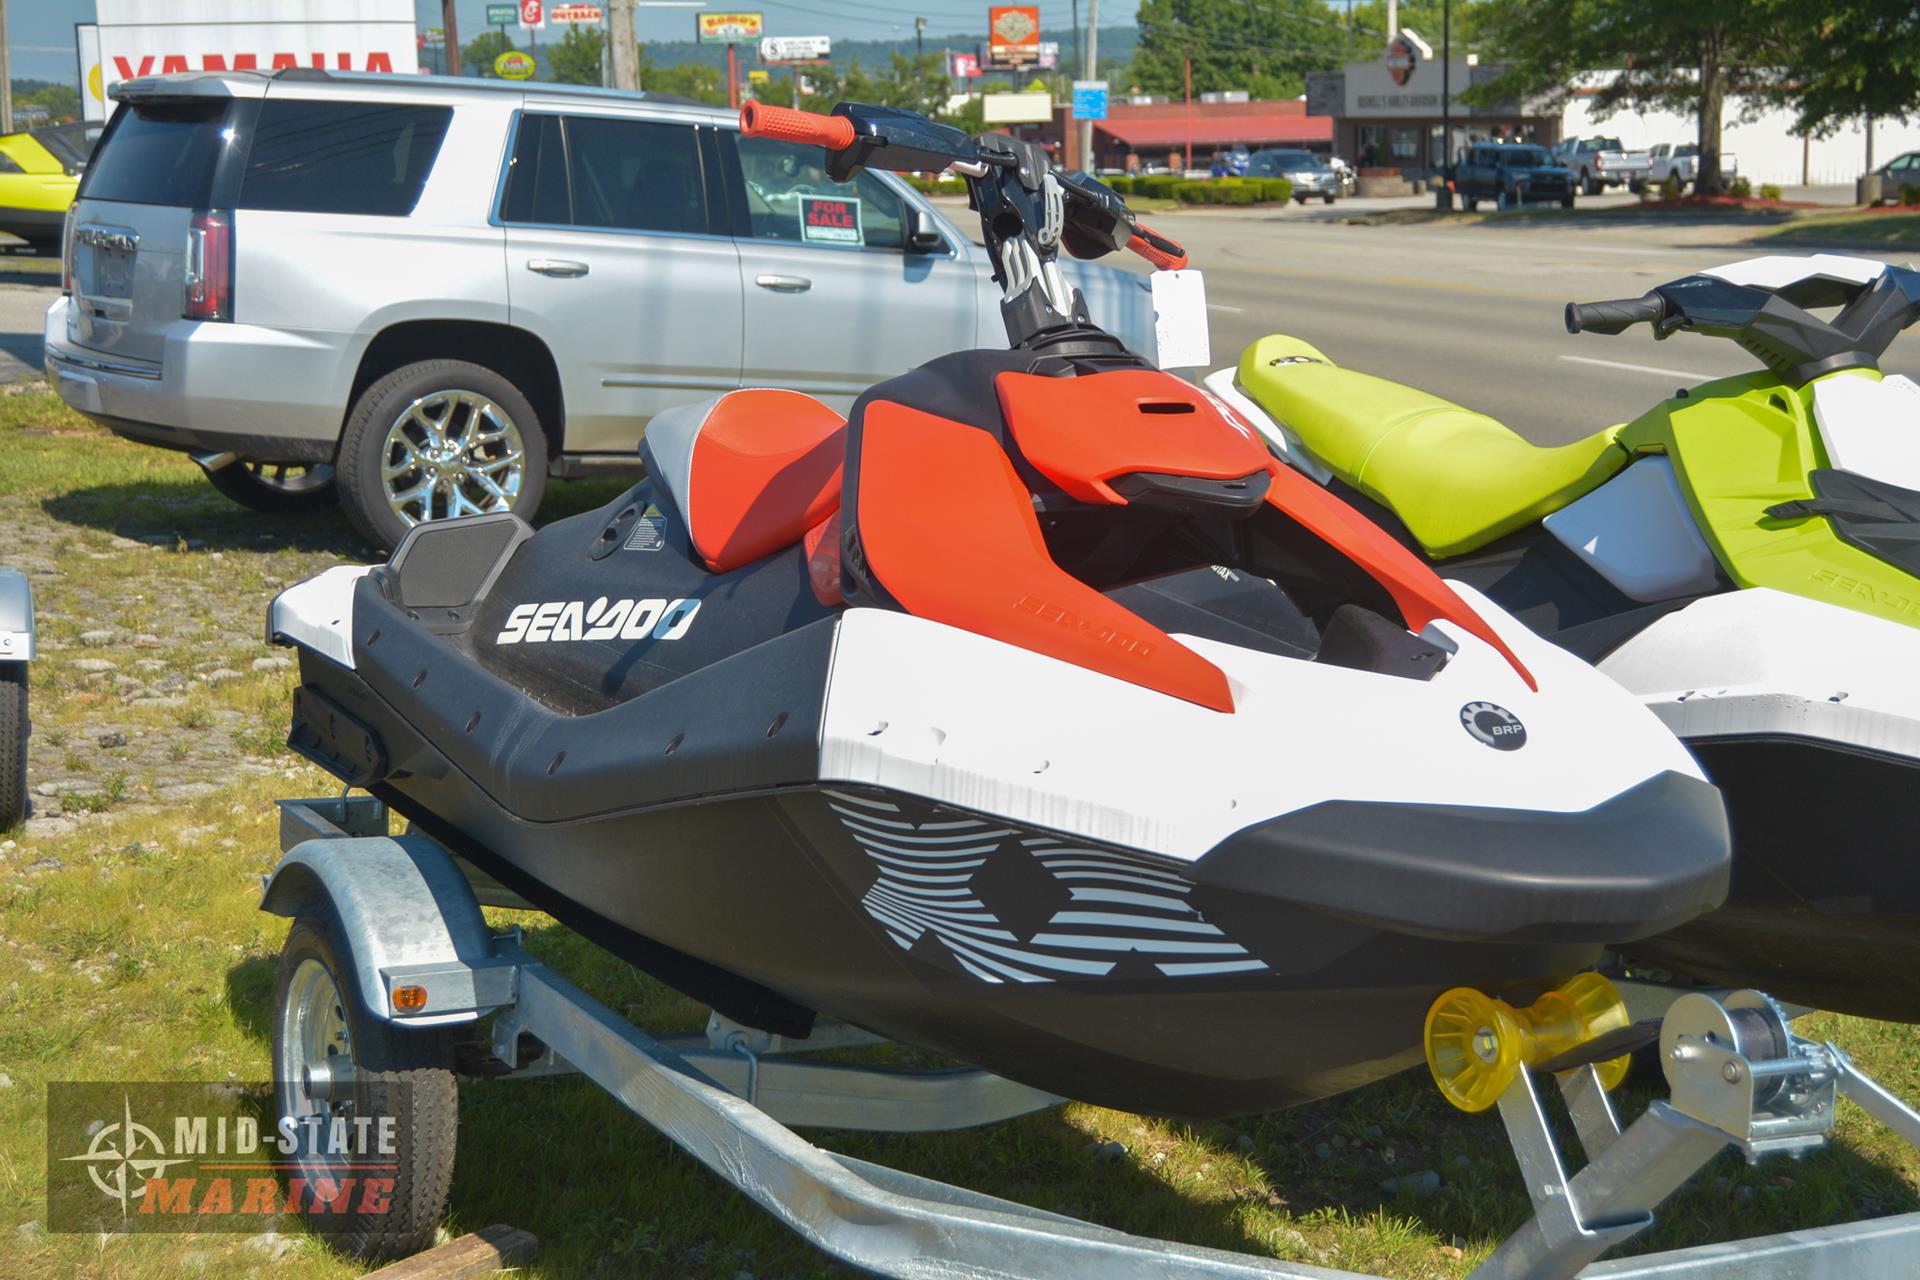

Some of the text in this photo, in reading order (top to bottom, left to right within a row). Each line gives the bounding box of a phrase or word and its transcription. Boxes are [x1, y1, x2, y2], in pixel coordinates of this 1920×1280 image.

[812, 201, 848, 214] FOR
[807, 211, 855, 228] SALE
[1491, 724, 1523, 735] BRP
